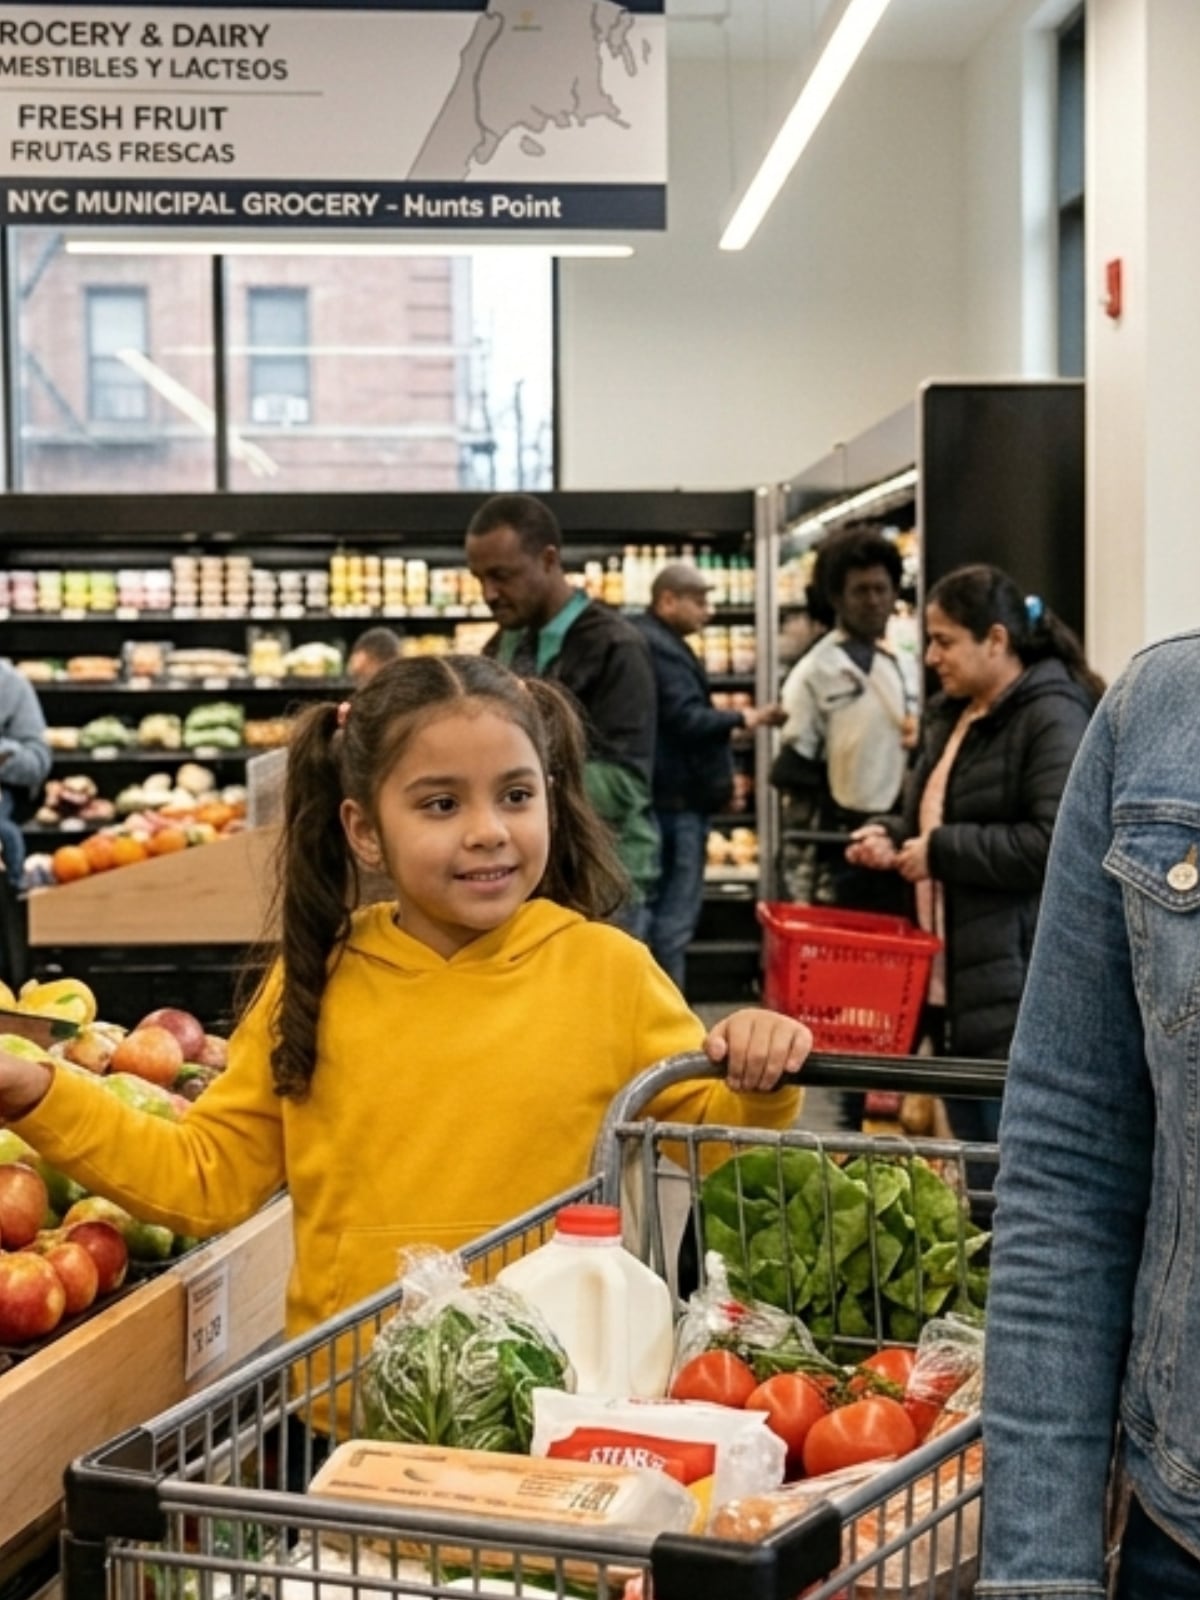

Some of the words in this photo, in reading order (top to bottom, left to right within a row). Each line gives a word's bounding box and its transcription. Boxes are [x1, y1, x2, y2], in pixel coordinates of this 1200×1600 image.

[0, 20, 131, 47] ROCERY
[140, 23, 163, 47] &
[172, 23, 270, 48] DAIRY
[146, 57, 163, 78] Y
[19, 104, 123, 130] FRESH
[134, 105, 228, 131] FRUIT
[10, 140, 112, 162] FRUTAS
[119, 142, 236, 164] FRESCAS
[7, 189, 69, 214] NYC
[76, 190, 235, 215] MUNICIPAL
[242, 192, 380, 216] GROCERY
[490, 194, 562, 218] Point
